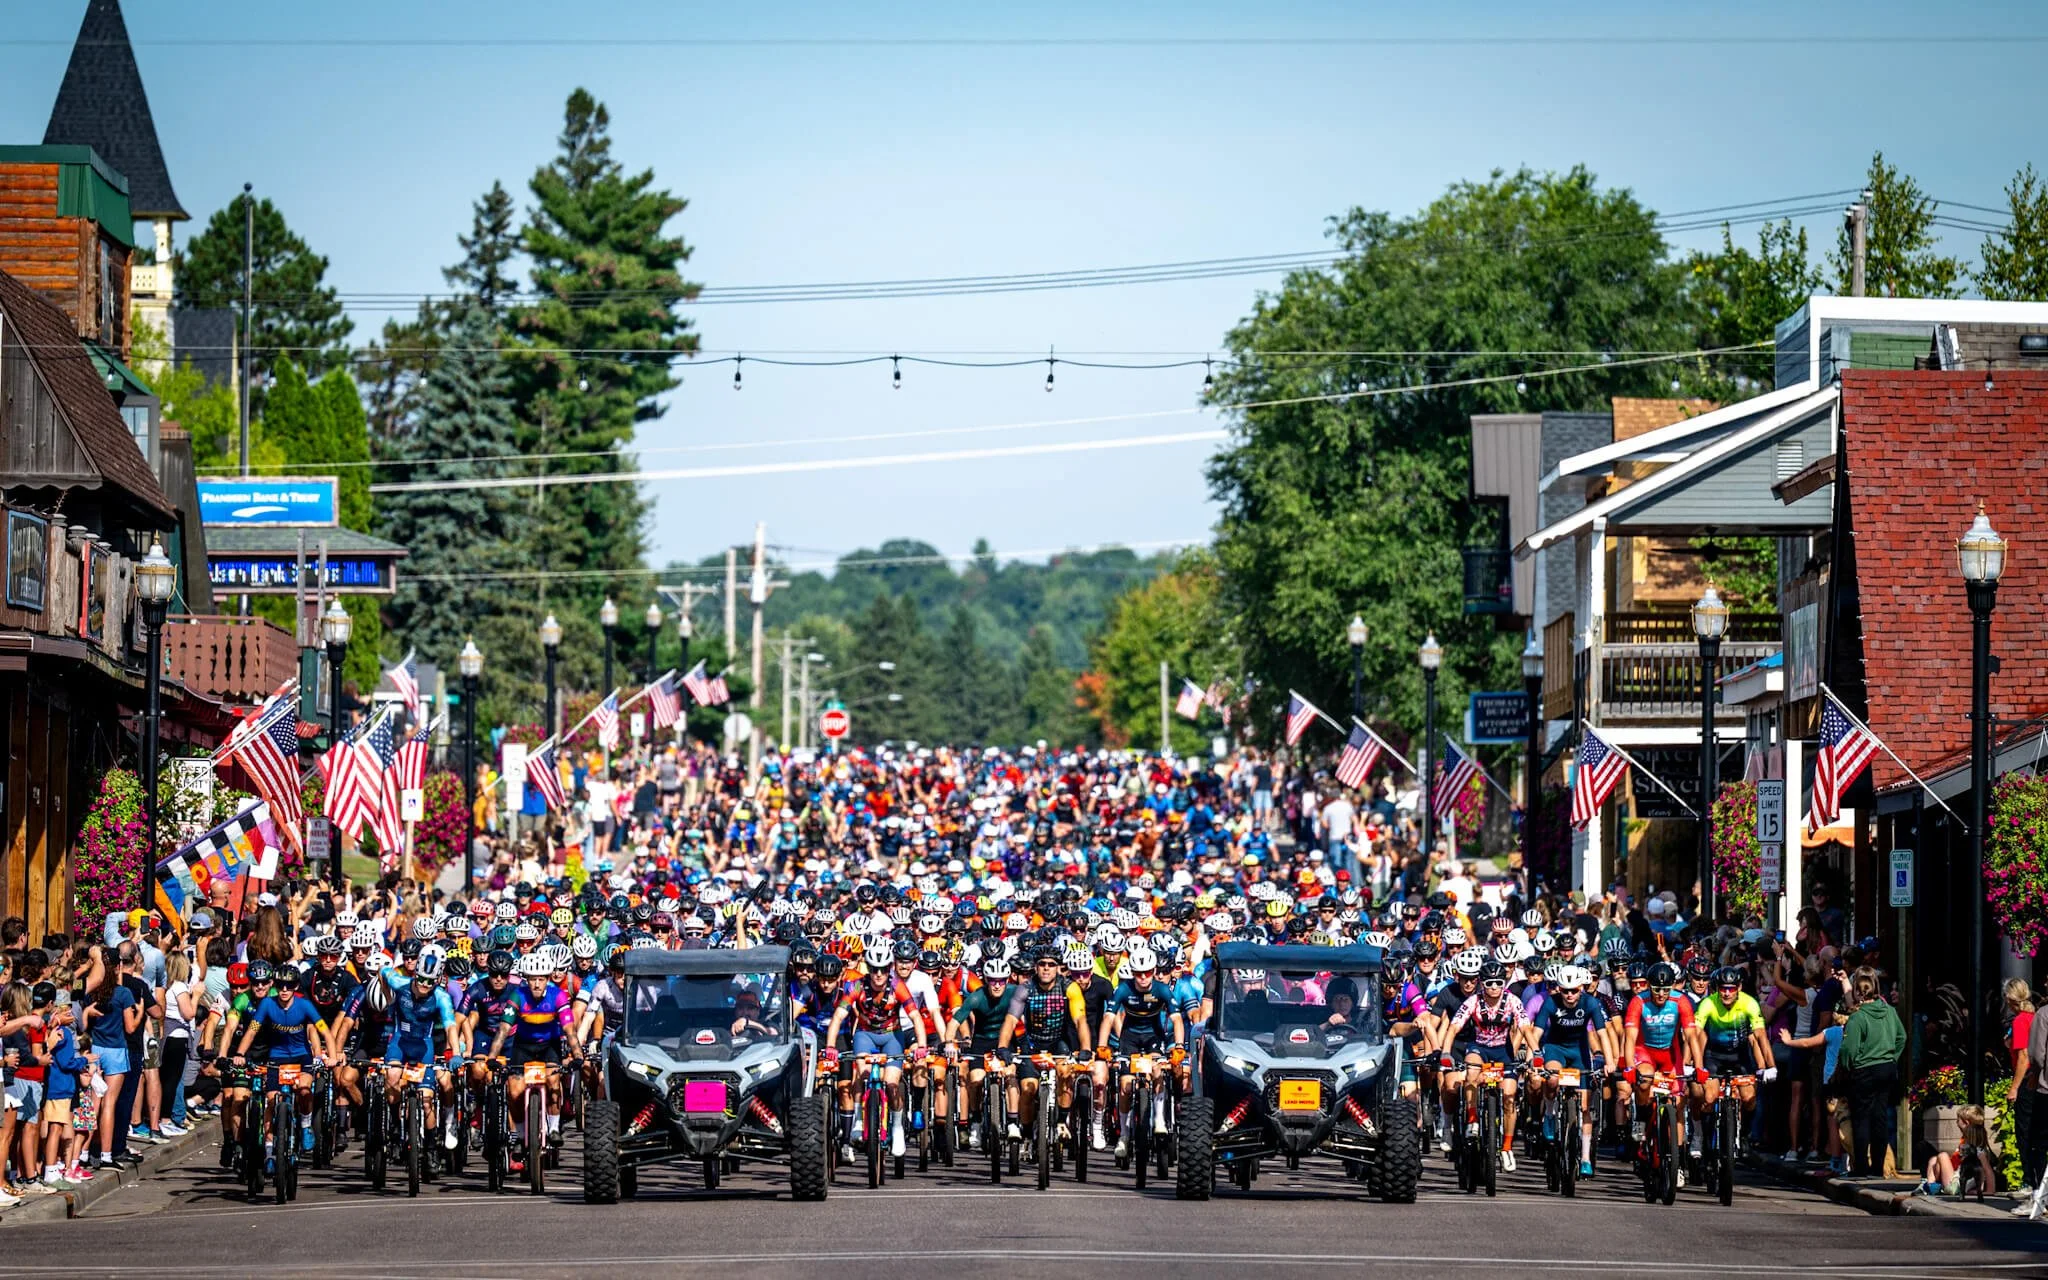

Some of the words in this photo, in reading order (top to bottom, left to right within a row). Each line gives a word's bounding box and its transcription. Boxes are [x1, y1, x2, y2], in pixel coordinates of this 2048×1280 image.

[822, 717, 848, 731] STOP
[1759, 786, 1782, 796] SPEED
[1761, 800, 1778, 809] LIMIT
[1763, 813, 1778, 836] 15
[190, 834, 251, 885] OPEN
